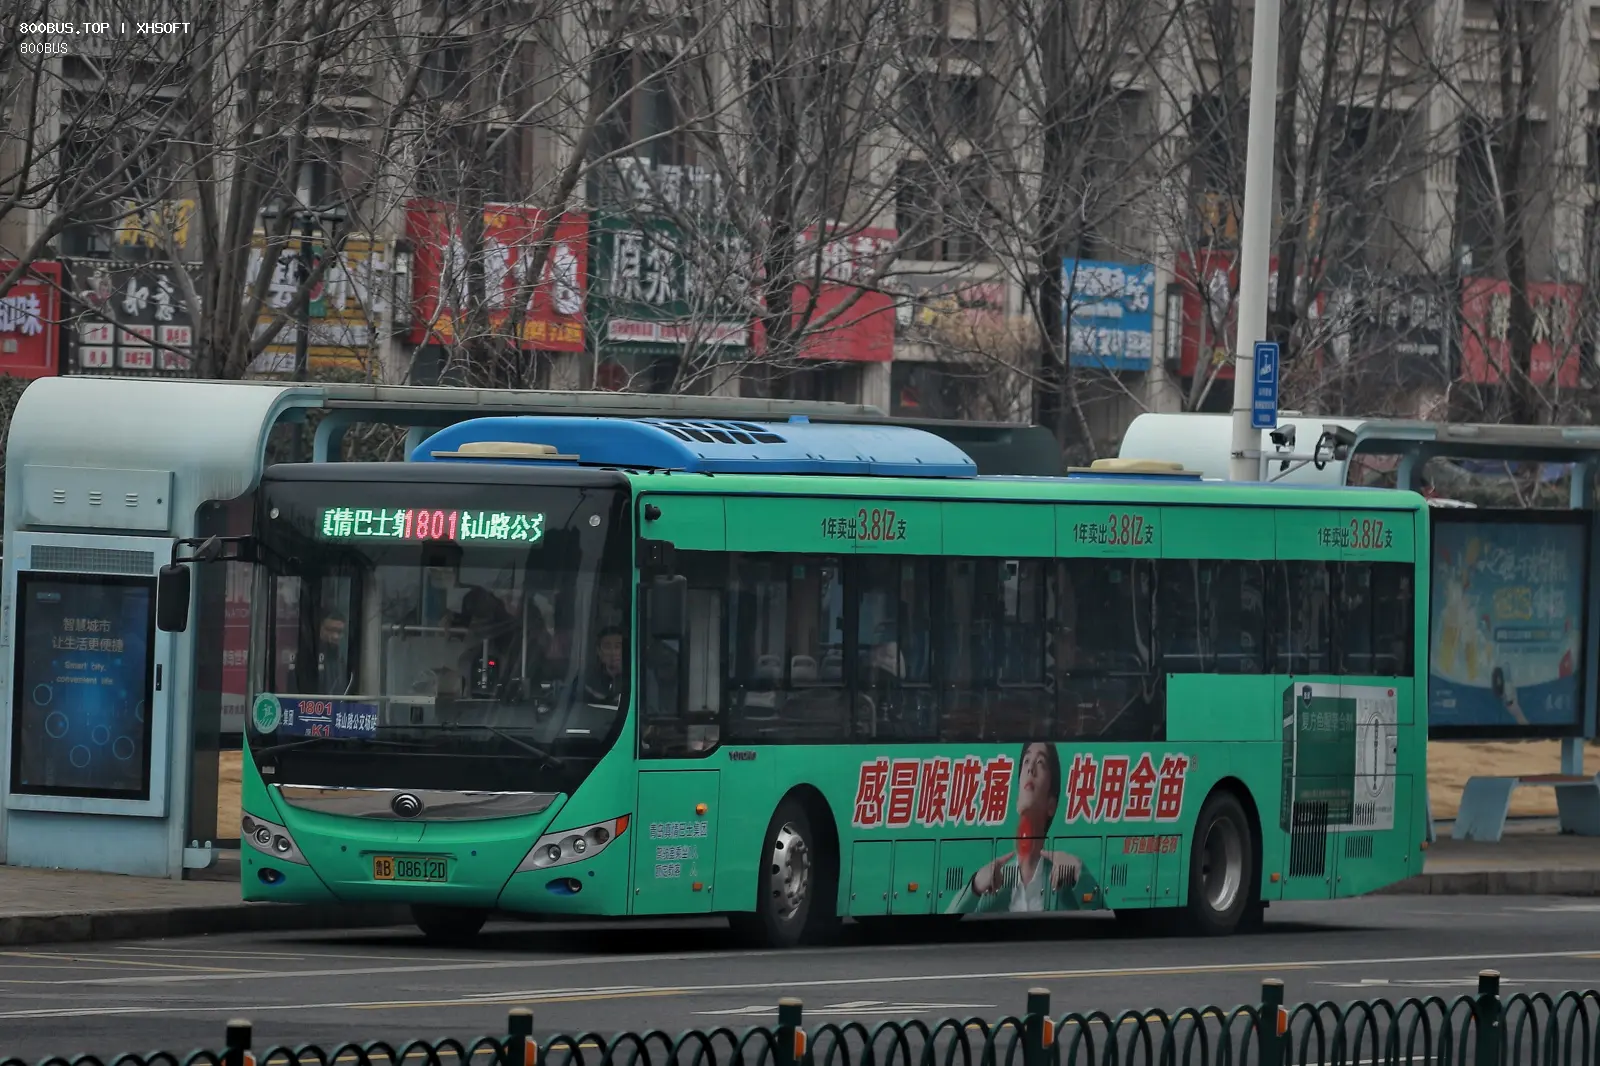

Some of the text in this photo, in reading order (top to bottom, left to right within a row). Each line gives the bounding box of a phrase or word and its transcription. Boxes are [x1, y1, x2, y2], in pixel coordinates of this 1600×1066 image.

[404, 509, 457, 540] 1801
[63, 617, 112, 632] 智慧城市
[52, 635, 124, 653] 让生活更便捷
[298, 700, 333, 716] 1801
[852, 752, 1189, 828] 感冒喉咙痛 快用金笛
[397, 860, 446, 879] 08612D
